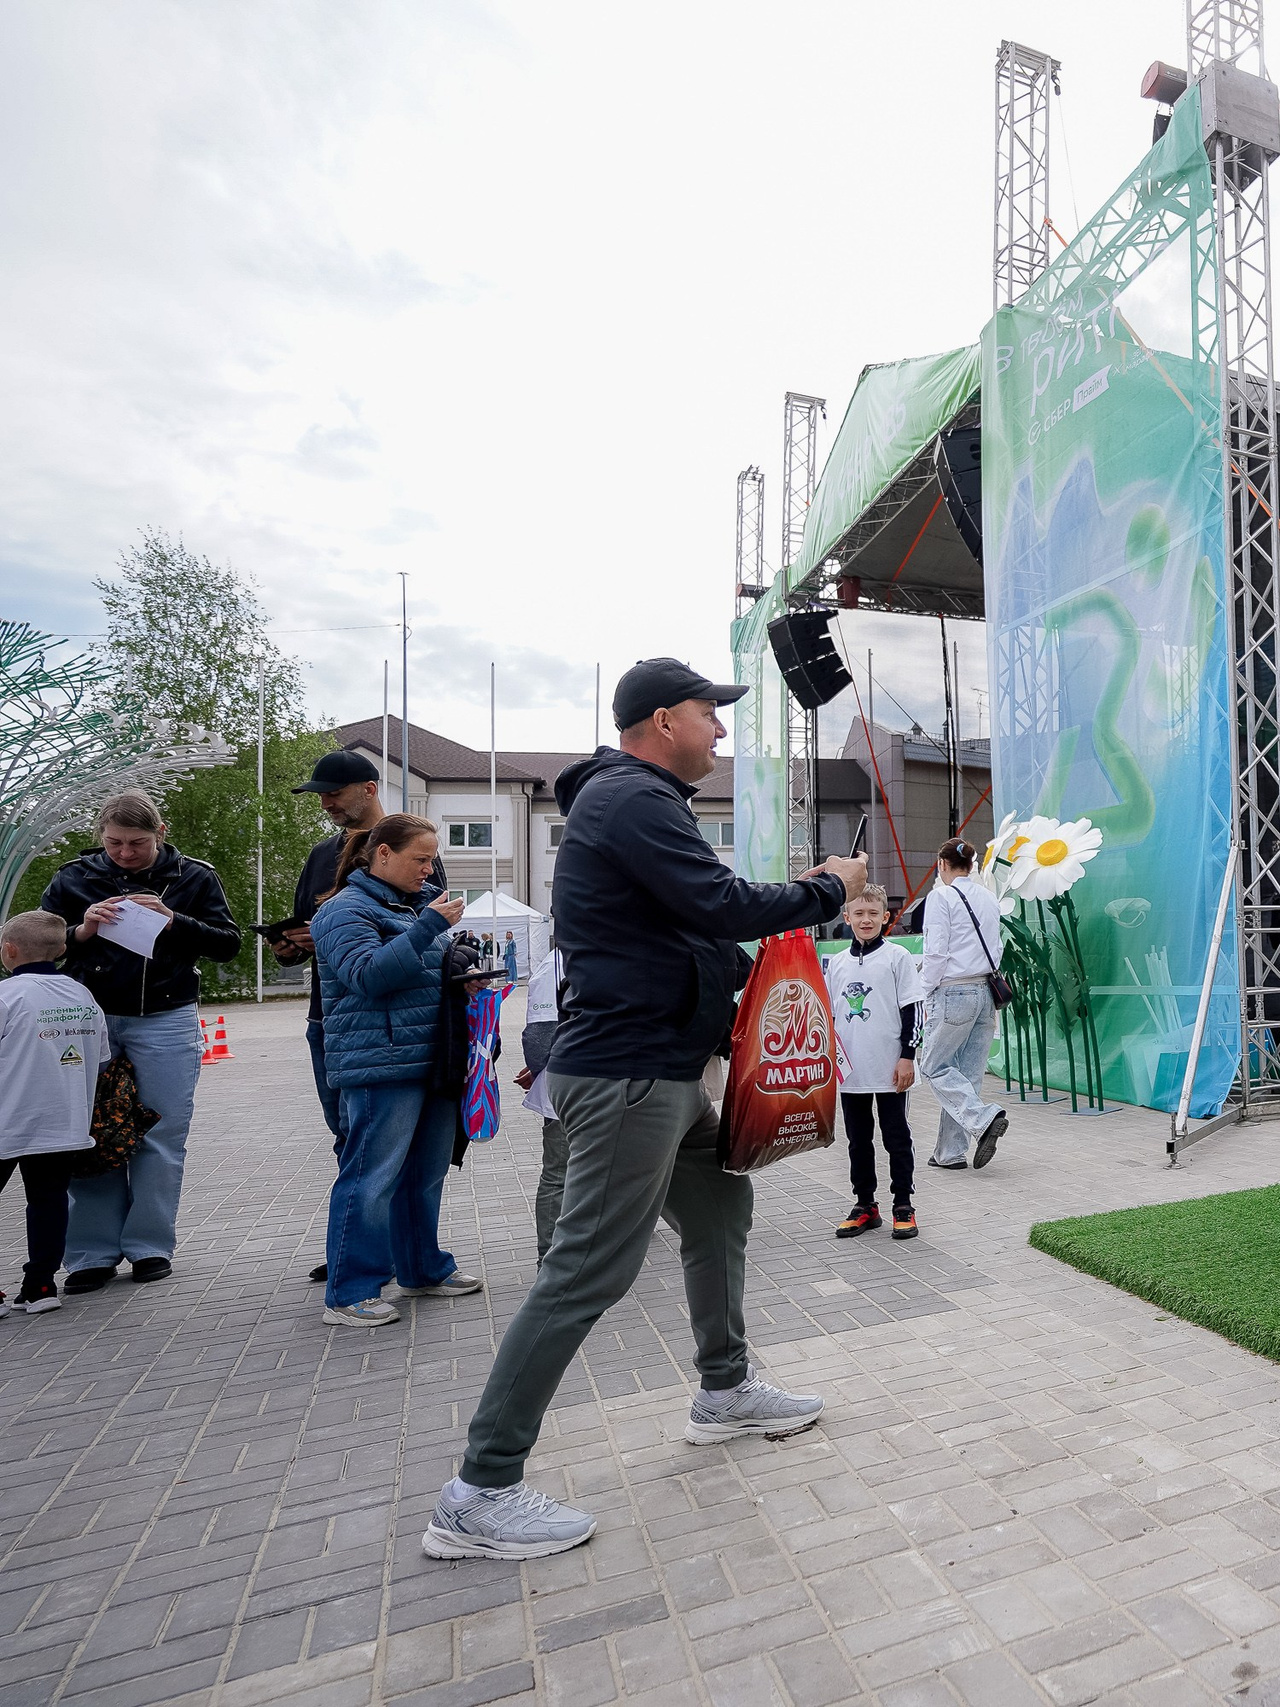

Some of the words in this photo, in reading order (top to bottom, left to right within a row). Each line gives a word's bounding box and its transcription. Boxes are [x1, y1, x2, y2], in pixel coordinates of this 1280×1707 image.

[1044, 398, 1071, 433] СБЕР
[40, 1004, 83, 1016] зелёный
[36, 1014, 80, 1024] марафон
[765, 1062, 825, 1085] МАРТИН
[784, 1111, 815, 1123] ВСЕГДА
[778, 1121, 818, 1135] ВЫСОКОЕ
[773, 1131, 819, 1147] КАЧЕСТВО!
